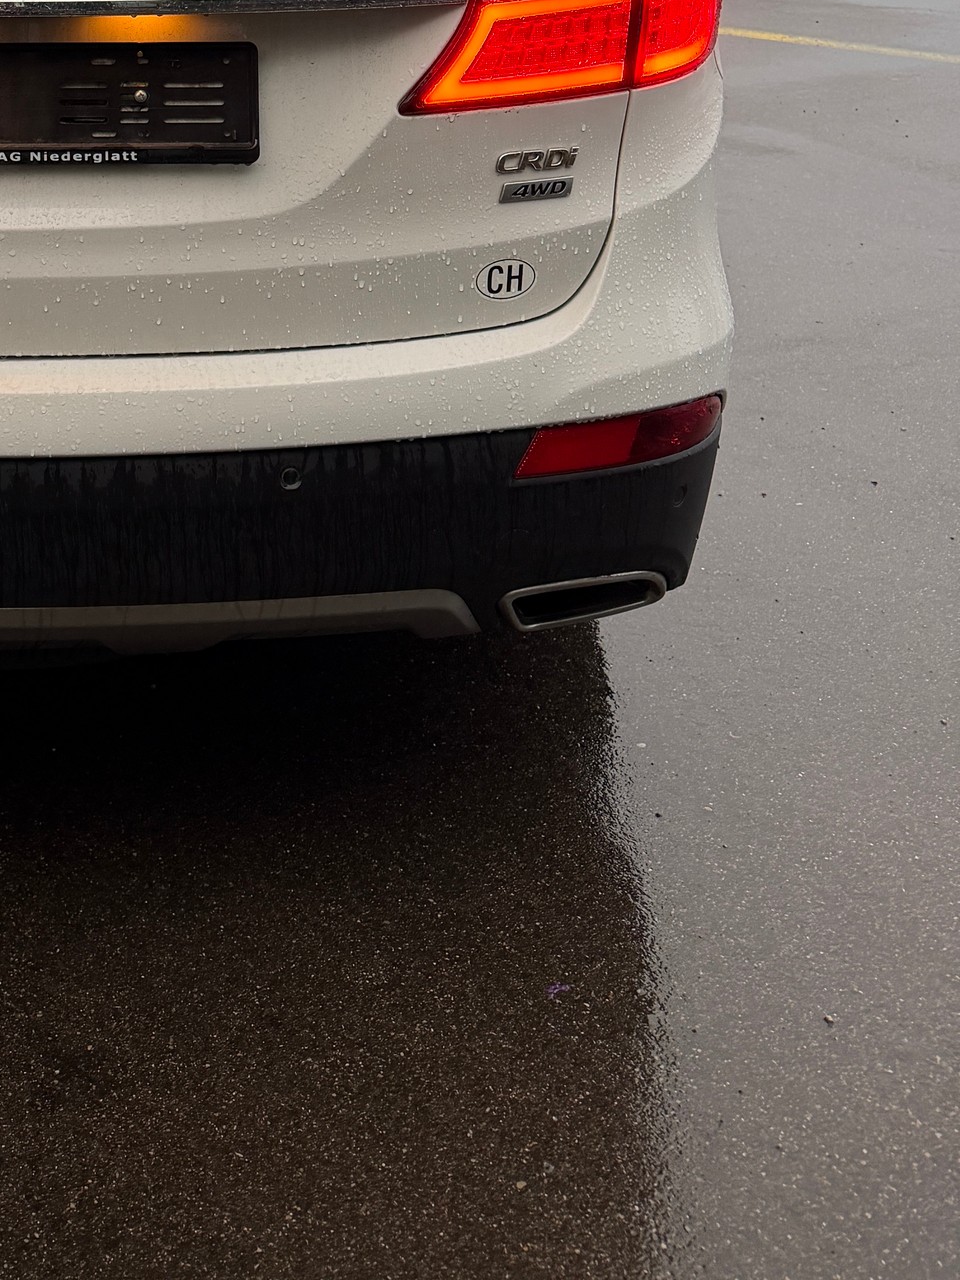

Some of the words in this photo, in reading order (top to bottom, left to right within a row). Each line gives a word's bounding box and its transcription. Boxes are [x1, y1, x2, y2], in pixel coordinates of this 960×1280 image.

[29, 150, 139, 163] Niederglatt
[511, 180, 567, 199] 4WD
[487, 263, 524, 294] CH
